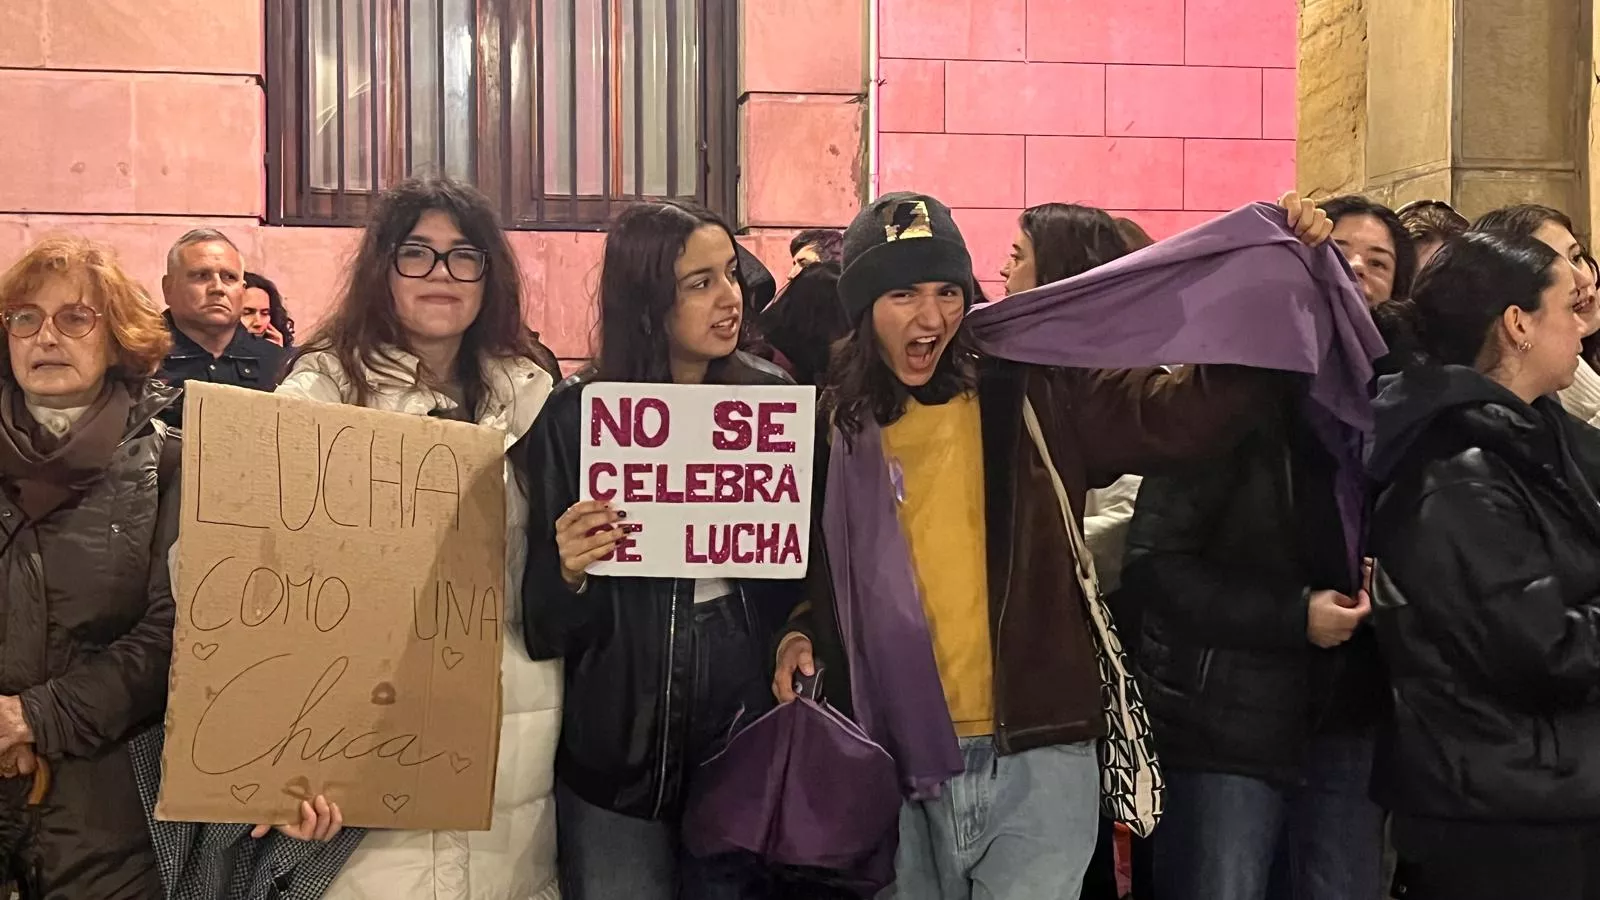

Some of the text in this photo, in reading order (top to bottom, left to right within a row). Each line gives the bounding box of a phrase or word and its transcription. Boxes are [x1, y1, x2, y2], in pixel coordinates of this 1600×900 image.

[590, 397, 797, 453] NO SE
[196, 397, 460, 531] LUCHA
[588, 462, 800, 503] CELEBRA
[685, 523, 802, 564] LUCHA
[190, 556, 498, 641] COMO UNA
[191, 653, 446, 775] Chica
